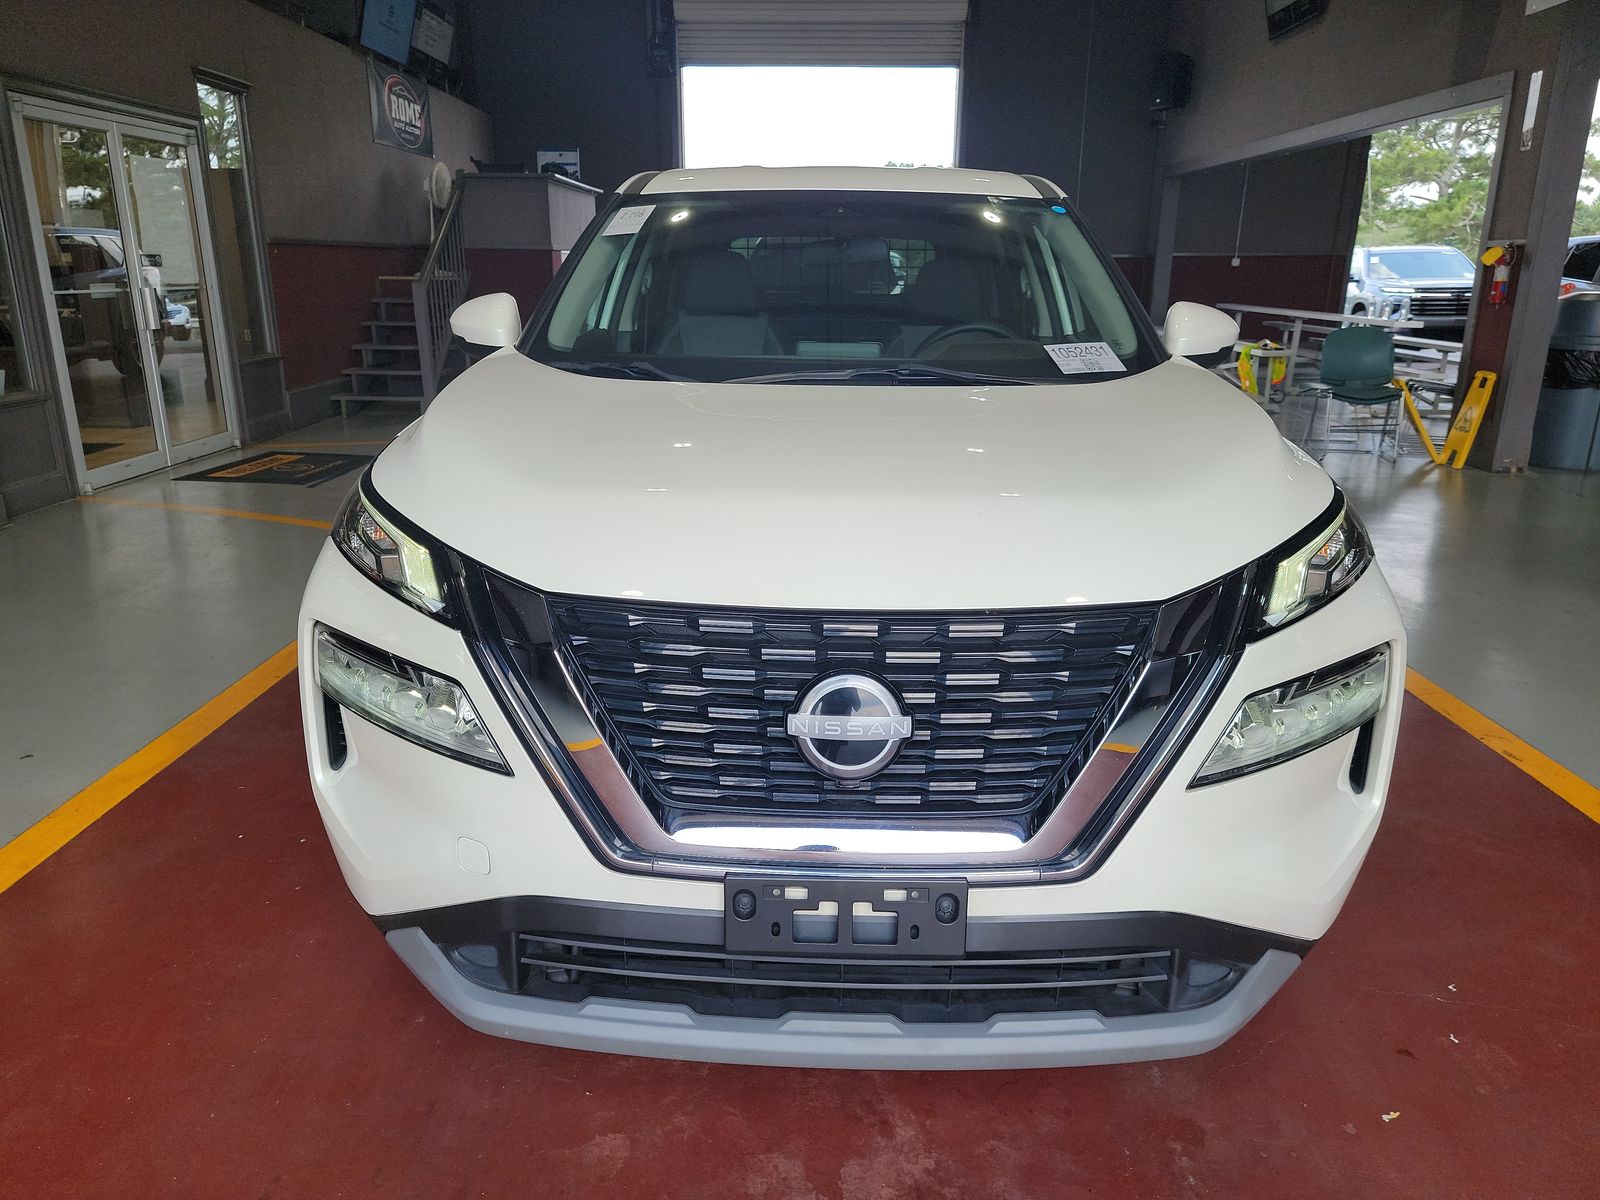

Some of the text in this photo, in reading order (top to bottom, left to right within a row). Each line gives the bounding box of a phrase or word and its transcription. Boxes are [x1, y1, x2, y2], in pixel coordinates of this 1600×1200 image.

[390, 94, 421, 127] ROME
[1050, 345, 1108, 358] 1052431
[791, 719, 907, 736] NISSAN
